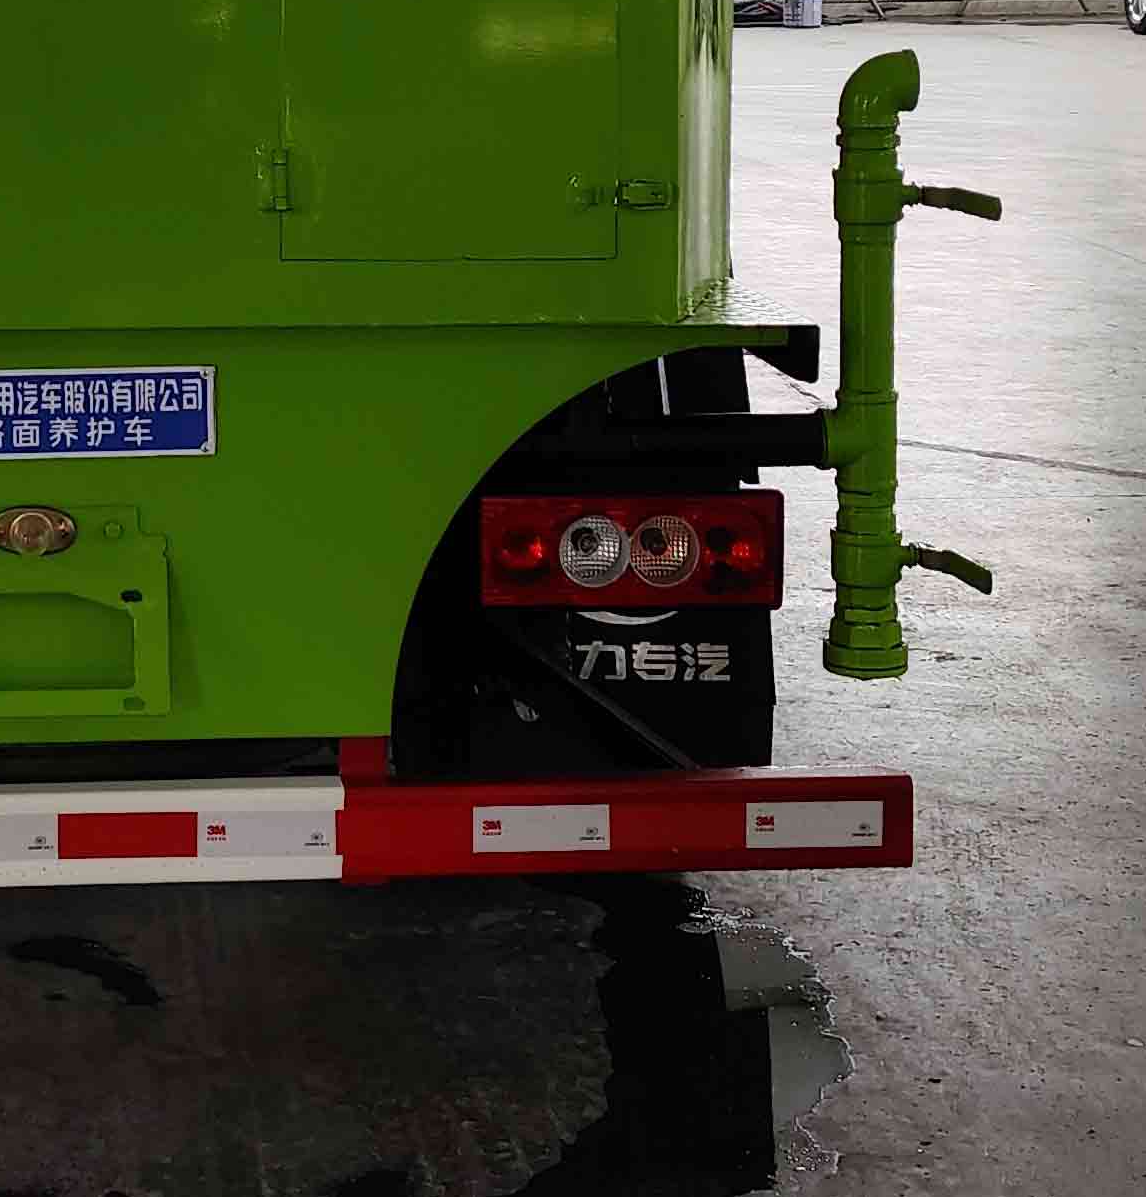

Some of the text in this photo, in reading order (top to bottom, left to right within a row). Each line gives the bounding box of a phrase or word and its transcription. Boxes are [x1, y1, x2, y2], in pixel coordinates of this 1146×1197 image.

[566, 641, 730, 682] 力专汽
[481, 819, 501, 831] 3M
[755, 815, 775, 827] 3M
[206, 825, 227, 837] 3M
